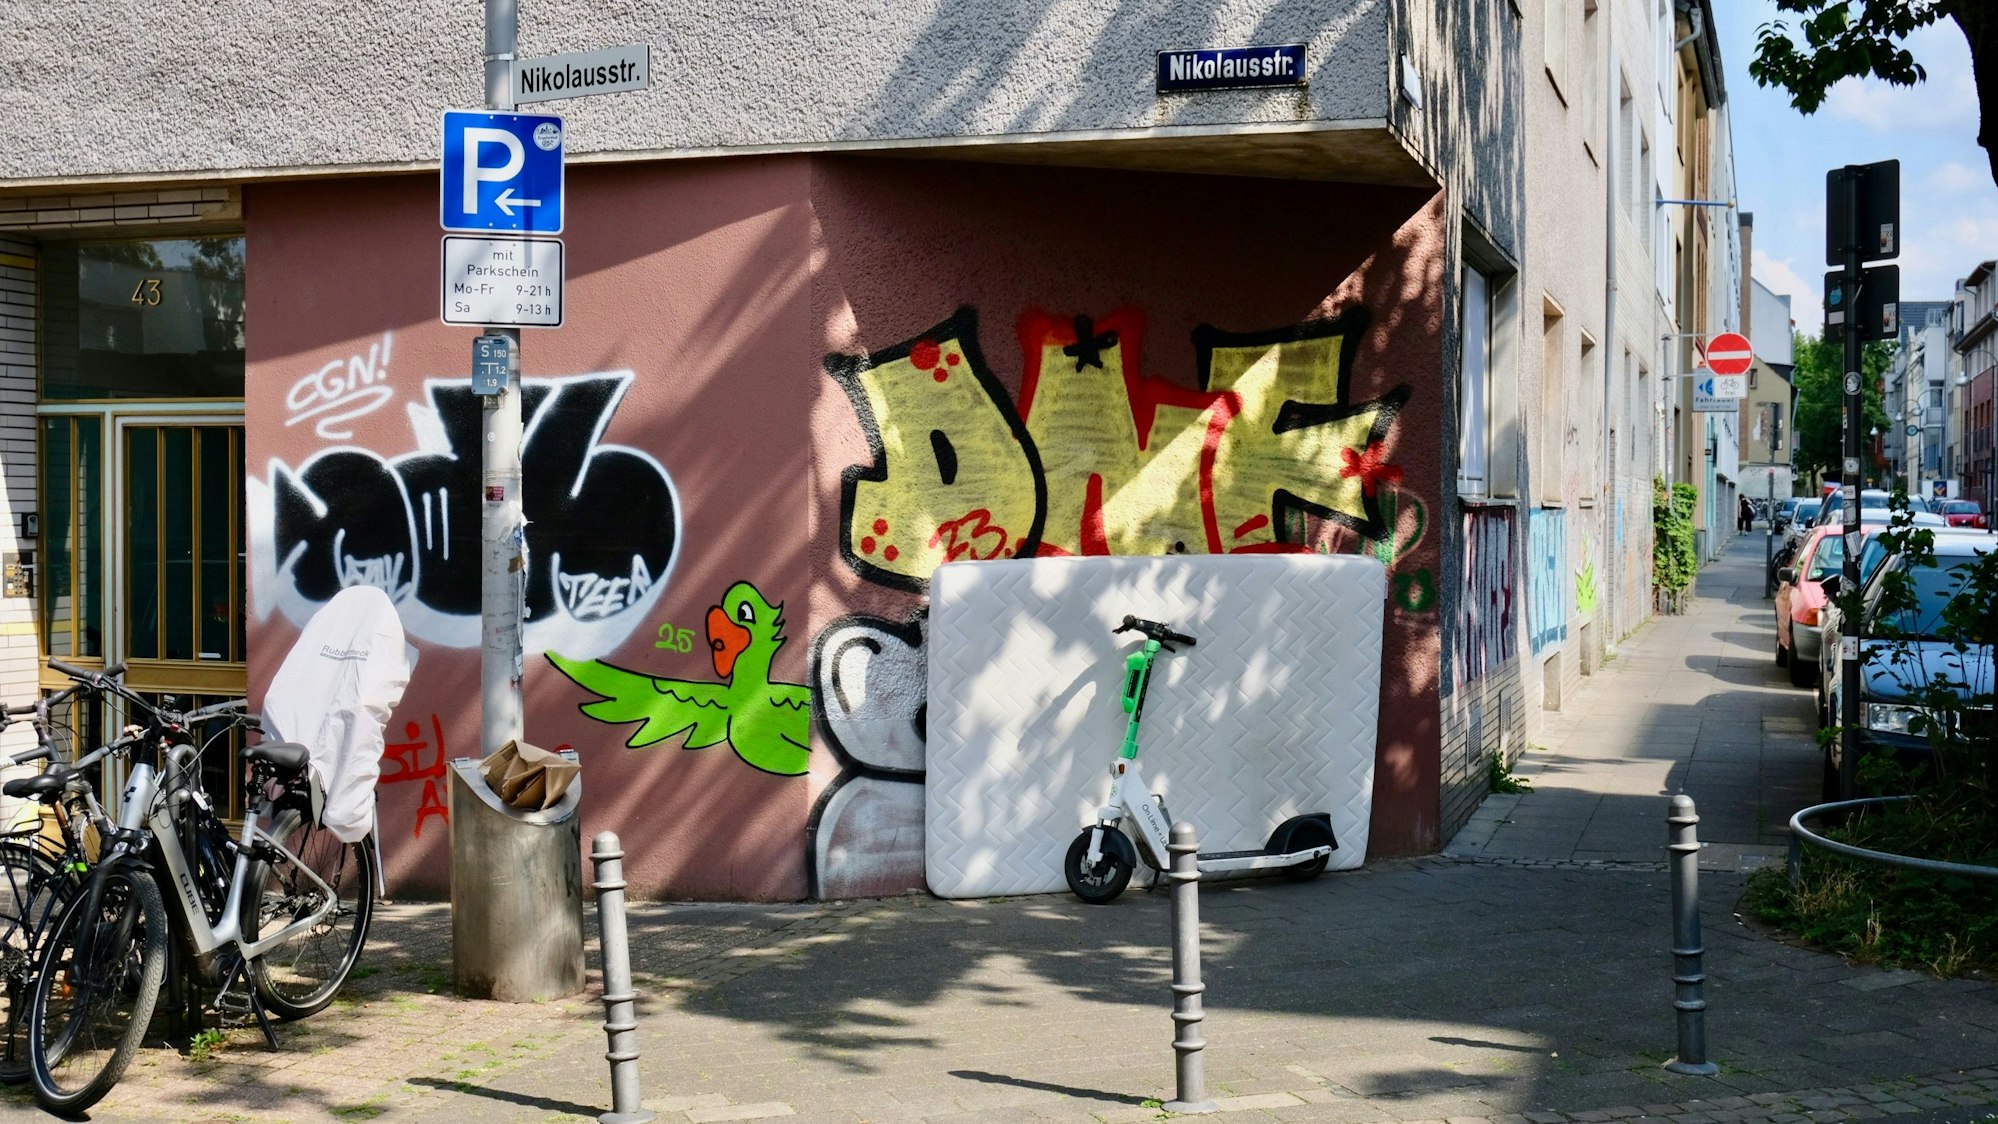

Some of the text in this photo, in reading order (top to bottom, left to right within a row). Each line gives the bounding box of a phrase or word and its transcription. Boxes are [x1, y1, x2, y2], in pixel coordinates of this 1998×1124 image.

[1170, 50, 1294, 81] Nikolausstr.
[521, 58, 640, 94] Nikolausstr.
[463, 127, 526, 214] P
[492, 250, 514, 260] mit
[467, 264, 539, 277] Parkschein
[131, 279, 161, 306] 43
[454, 283, 551, 297] Mo-Fr 9-21 h
[455, 302, 551, 315] Sa 9-13 h
[481, 344, 507, 358] S 150
[496, 365, 506, 375] 1.2
[487, 378, 497, 387] 1.9
[655, 623, 696, 654] 25
[1142, 804, 1150, 816] On
[1148, 815, 1160, 832] Lime
[180, 872, 200, 916] CUBE
